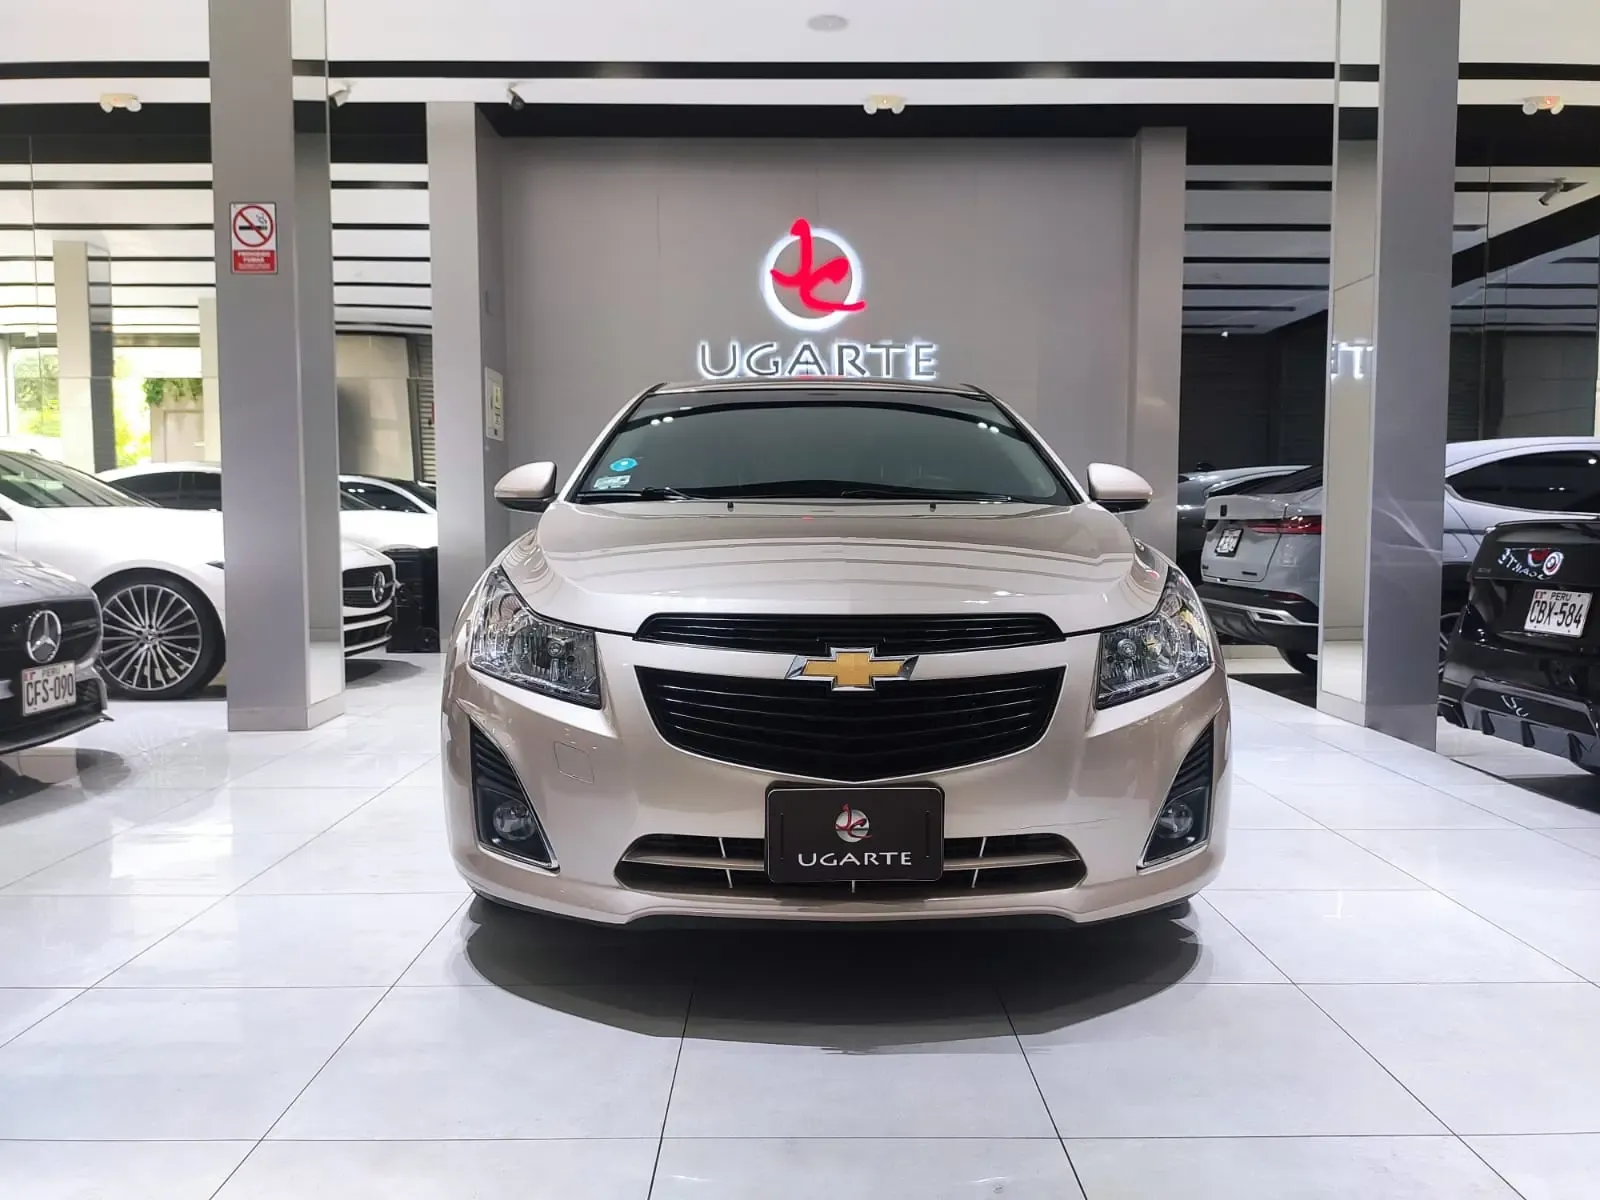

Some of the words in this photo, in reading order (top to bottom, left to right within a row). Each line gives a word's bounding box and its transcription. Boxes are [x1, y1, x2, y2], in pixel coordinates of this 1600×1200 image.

[699, 341, 938, 378] UGARTE
[1551, 591, 1573, 602] PERU
[1529, 600, 1584, 629] CBX-584
[26, 672, 74, 707] CFS-090
[797, 851, 913, 867] UGARTE
